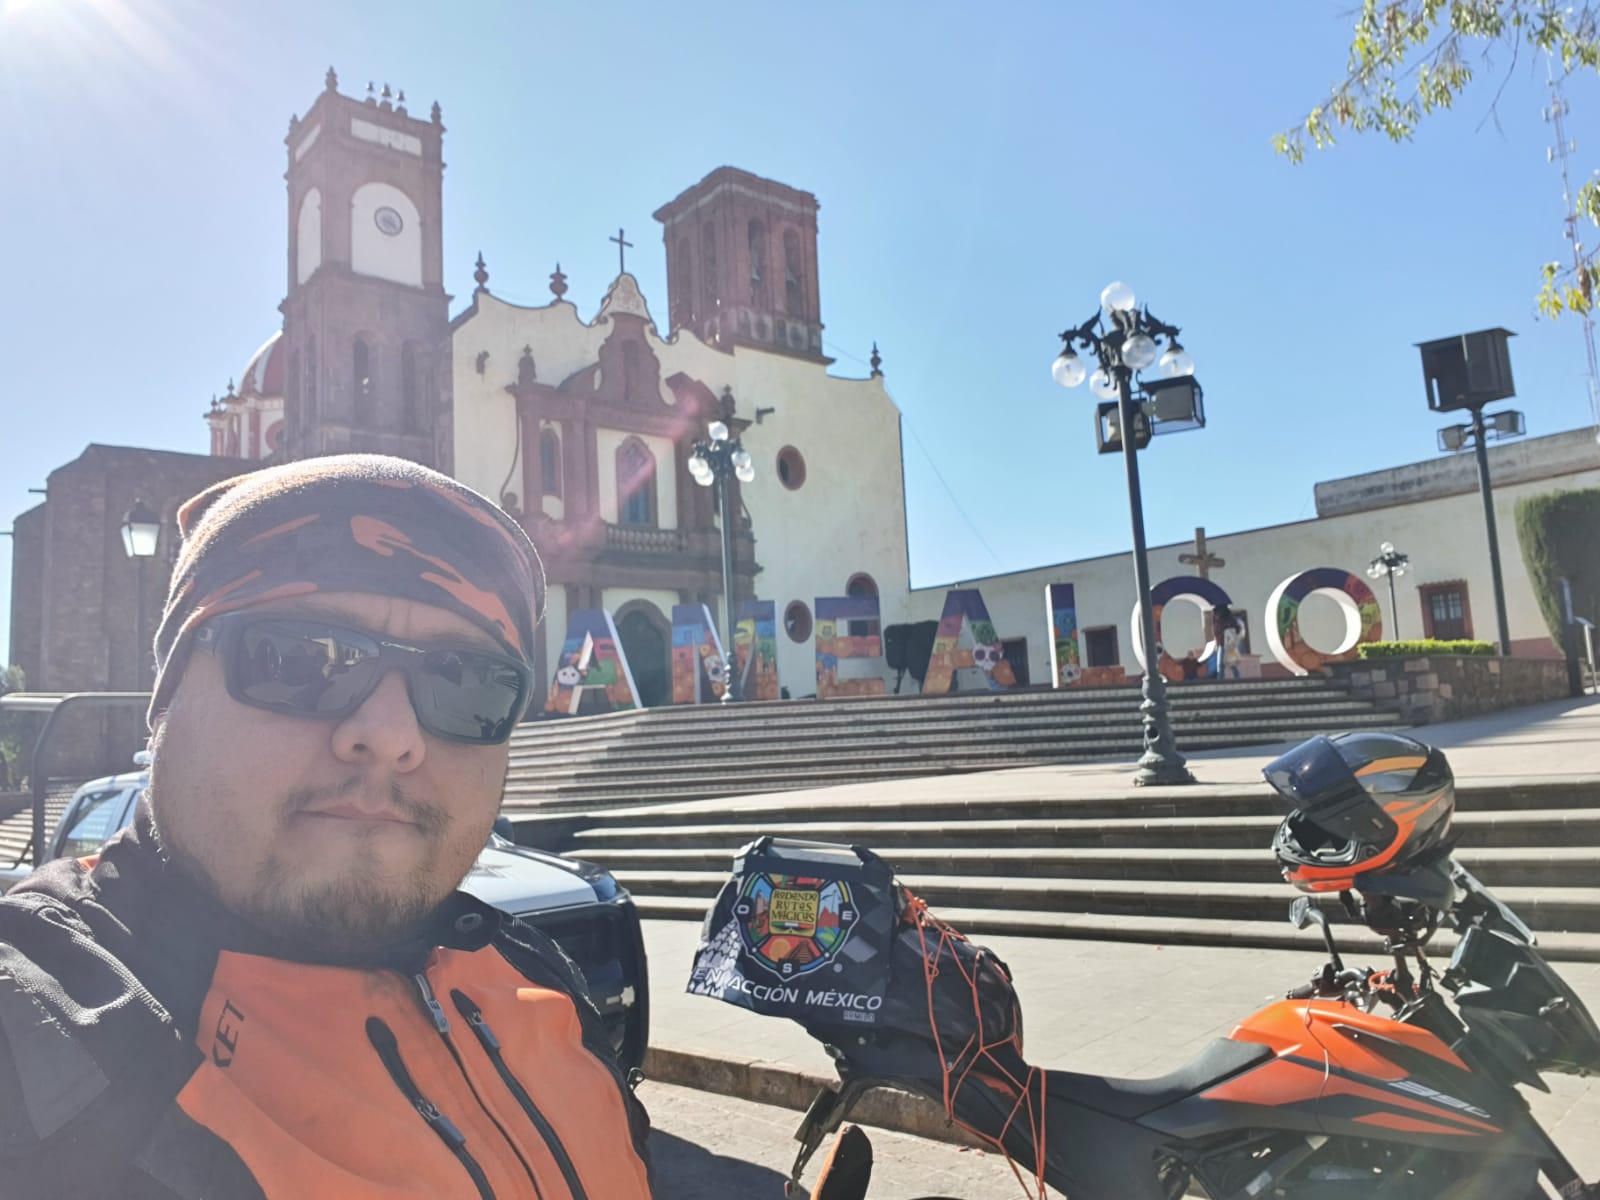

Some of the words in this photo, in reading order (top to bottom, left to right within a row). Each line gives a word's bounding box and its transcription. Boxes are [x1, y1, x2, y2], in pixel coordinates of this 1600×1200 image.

[544, 567, 1383, 716] AMEALCO
[842, 910, 853, 921] E
[782, 963, 793, 973] S
[728, 975, 799, 1004] ACCIÓN
[805, 988, 882, 1010] MÉXICO
